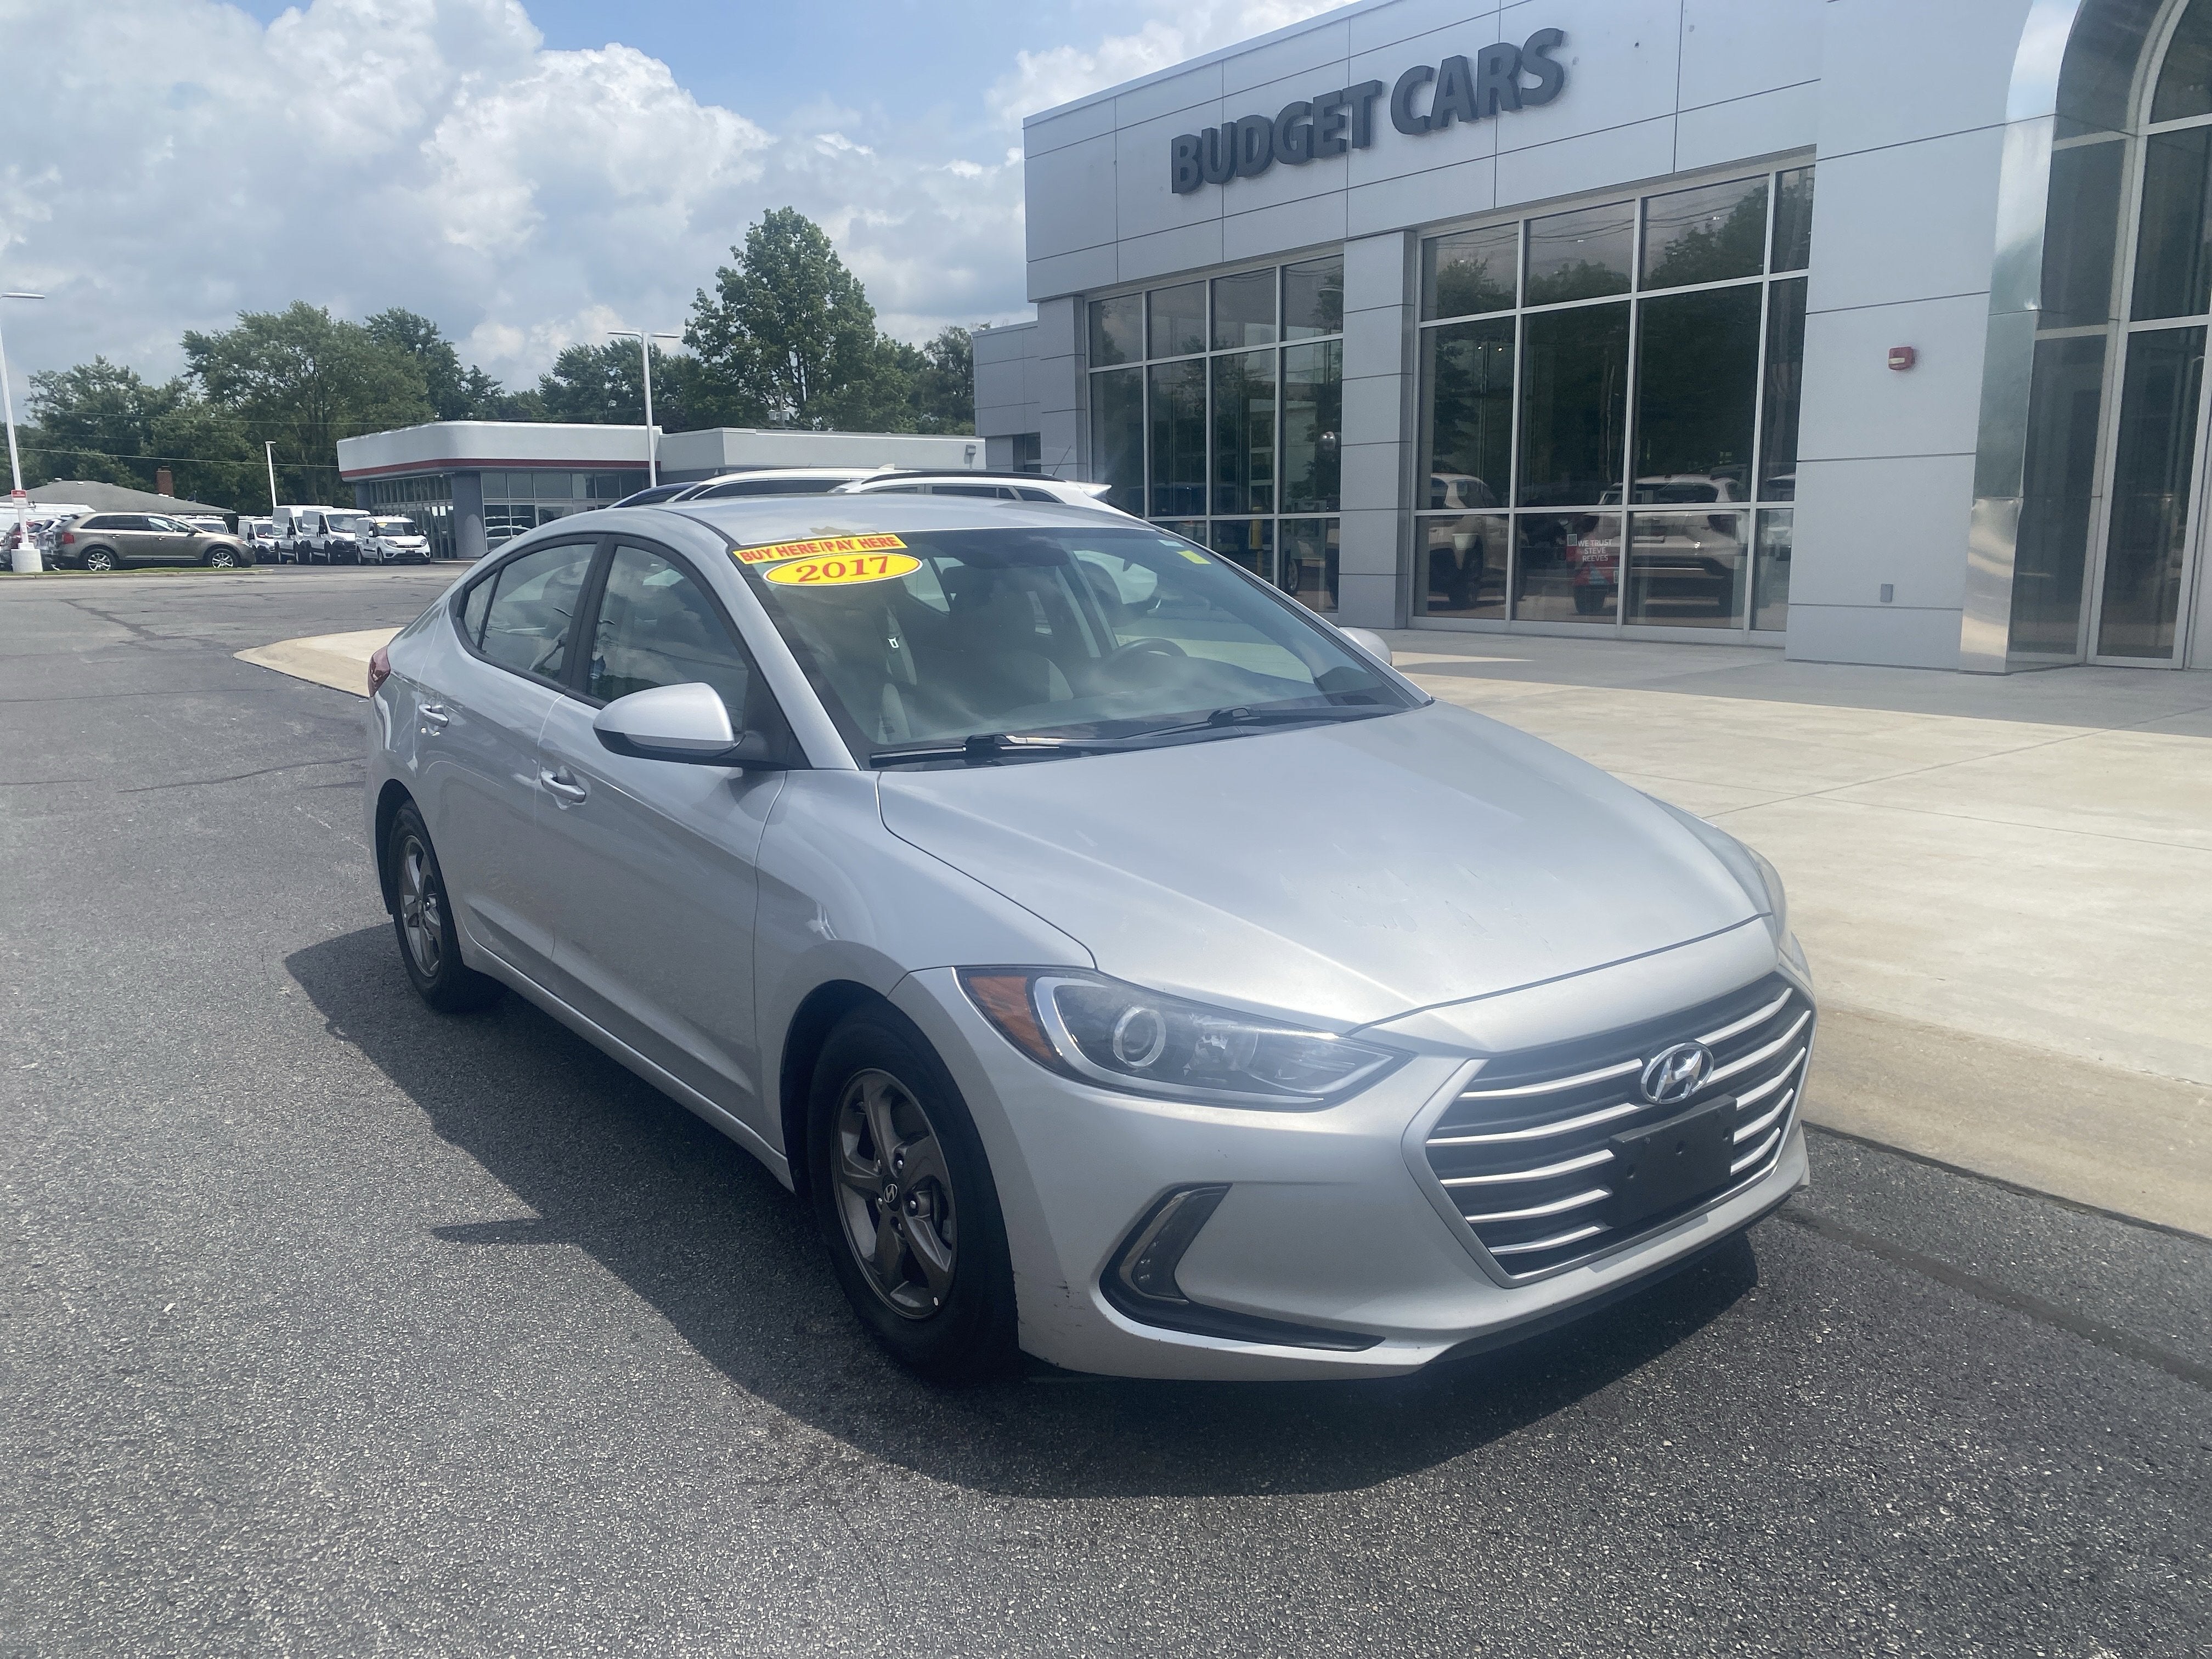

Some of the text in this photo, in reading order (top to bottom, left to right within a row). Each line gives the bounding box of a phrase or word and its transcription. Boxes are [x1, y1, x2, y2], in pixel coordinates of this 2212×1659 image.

[1171, 27, 1565, 194] BUDGET CARS
[741, 548, 773, 562] BUY
[857, 536, 901, 549] HERE
[796, 556, 888, 582] 2017
